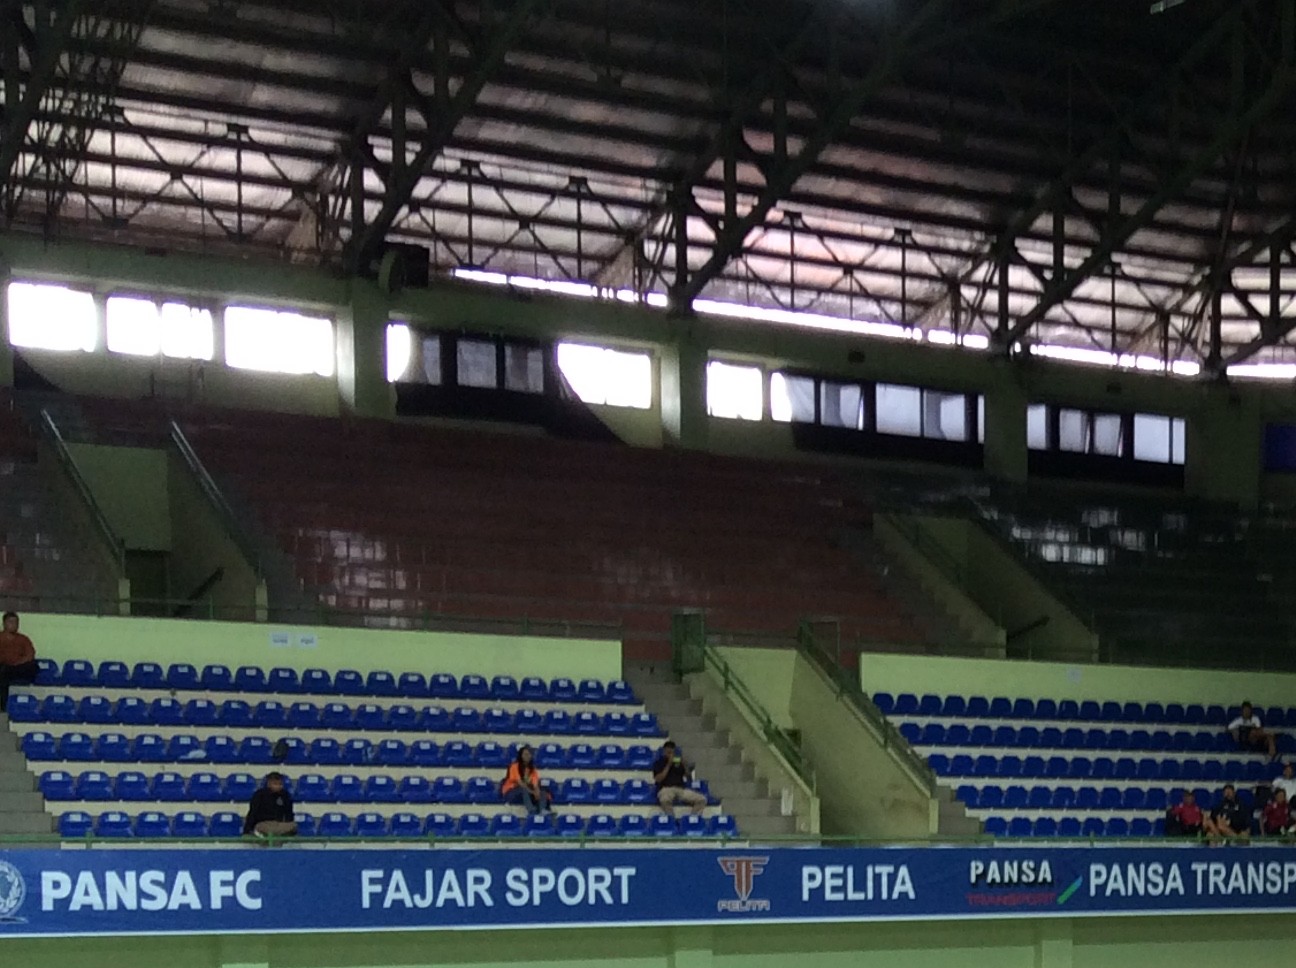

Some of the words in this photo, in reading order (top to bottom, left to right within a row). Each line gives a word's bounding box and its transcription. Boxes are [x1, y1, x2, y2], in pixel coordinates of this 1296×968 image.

[41, 869, 208, 911] PANSA
[210, 869, 262, 911] FC
[361, 869, 494, 909] FAJAR
[505, 866, 636, 907] SPORT
[802, 864, 916, 901] PELITA
[970, 860, 1053, 884] PANSA
[1089, 862, 1185, 898] PANSA
